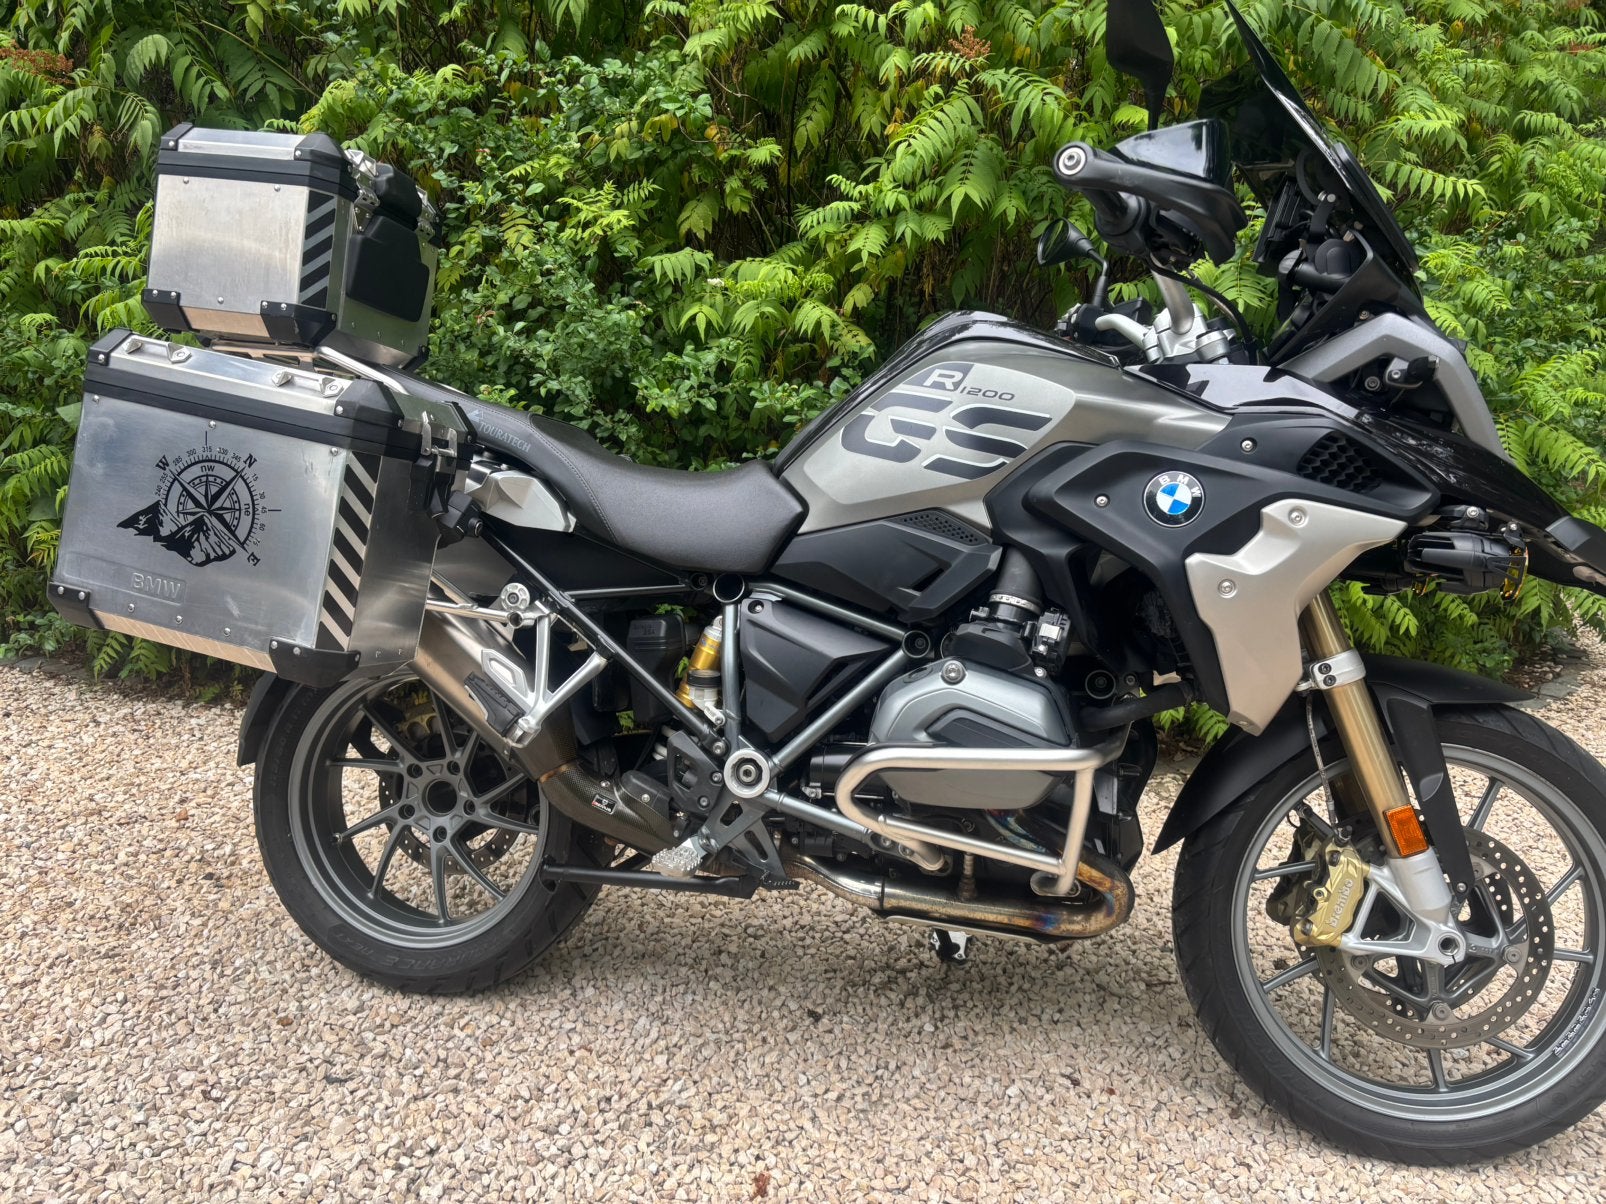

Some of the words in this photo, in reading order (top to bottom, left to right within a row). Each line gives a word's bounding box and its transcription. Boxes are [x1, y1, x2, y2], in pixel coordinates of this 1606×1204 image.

[922, 368, 963, 390] R
[960, 386, 1015, 401] 1200
[479, 421, 532, 453] TOURATECH
[840, 390, 1052, 480] GS
[186, 448, 197, 457] 300
[217, 446, 229, 456] 330
[155, 454, 170, 472] W
[172, 455, 183, 466] 285
[231, 452, 241, 463] 345
[243, 453, 257, 469] N
[200, 464, 215, 473] nw
[159, 472, 168, 484] 255
[251, 473, 259, 482] 15
[154, 484, 163, 497] 240
[1158, 474, 1202, 498] BMW
[258, 490, 266, 500] 30
[243, 503, 251, 517] ne
[261, 506, 267, 514] 45
[258, 523, 266, 532] 60
[252, 538, 261, 547] 75
[247, 552, 261, 567] E
[131, 572, 181, 599] BMW
